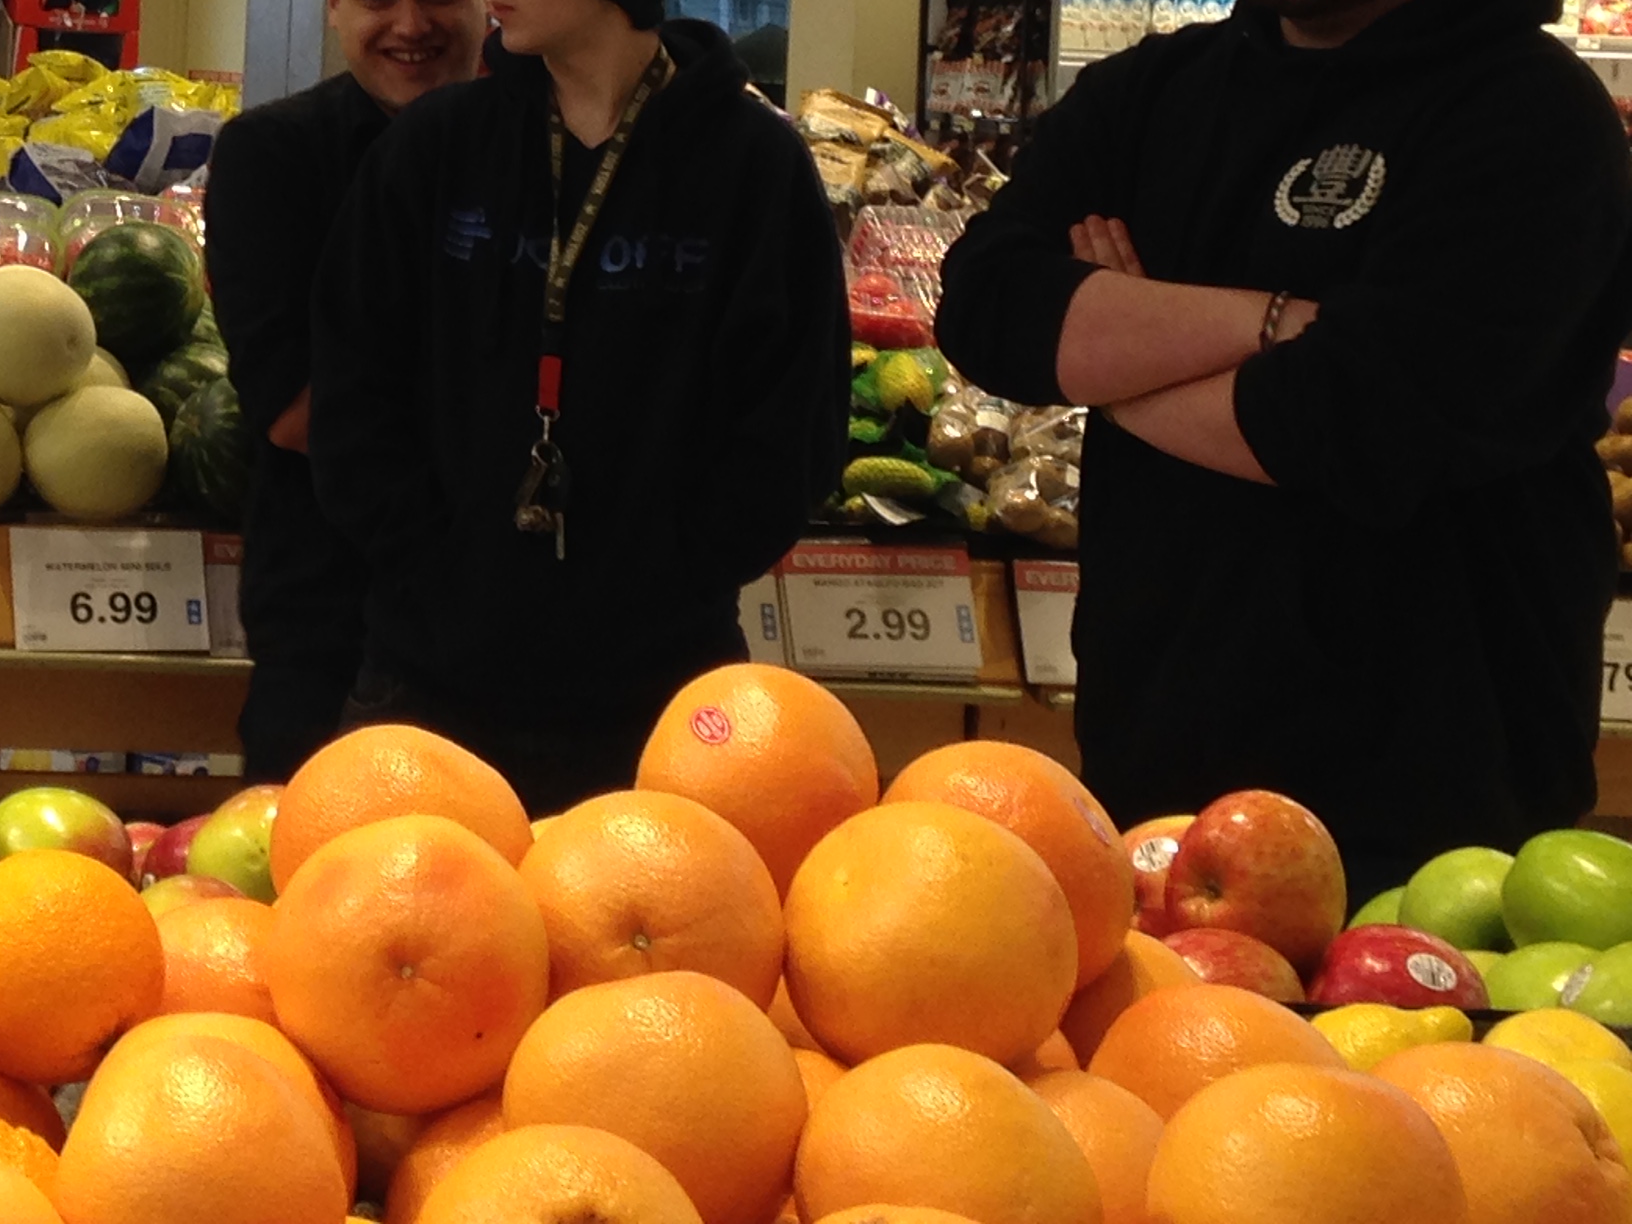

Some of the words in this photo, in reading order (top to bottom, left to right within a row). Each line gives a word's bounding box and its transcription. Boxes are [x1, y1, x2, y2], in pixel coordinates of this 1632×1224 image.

[45, 561, 117, 572] WATERMELON
[792, 553, 891, 569] EVERYDAY
[896, 554, 956, 571] PRICE
[70, 591, 158, 624] 6.99
[844, 607, 931, 642] 2.99
